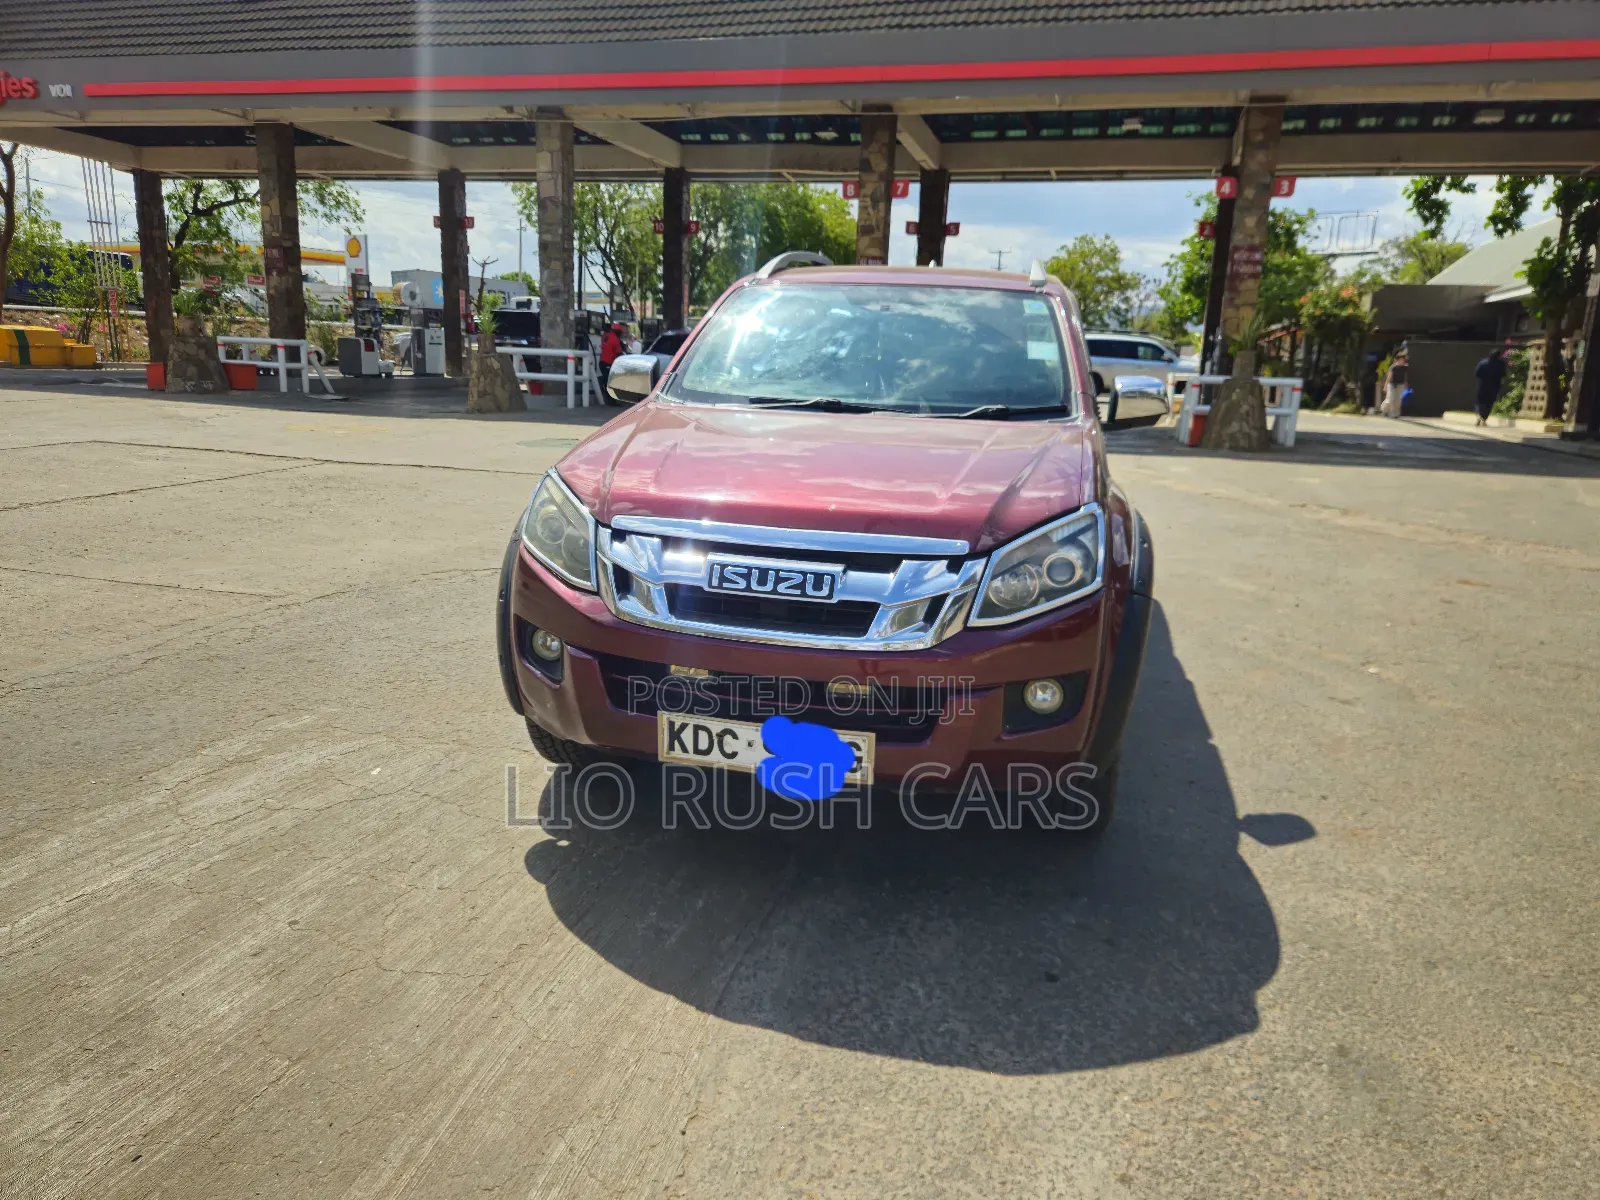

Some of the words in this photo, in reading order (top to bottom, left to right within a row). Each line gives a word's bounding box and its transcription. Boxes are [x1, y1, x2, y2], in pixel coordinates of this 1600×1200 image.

[846, 184, 855, 197] 8
[896, 183, 905, 196] 7
[1220, 181, 1231, 194] 4
[1279, 180, 1290, 194] 3
[690, 223, 697, 232] 9
[950, 225, 957, 234] 5
[711, 564, 832, 597] ISUZU
[667, 720, 739, 760] KDC
